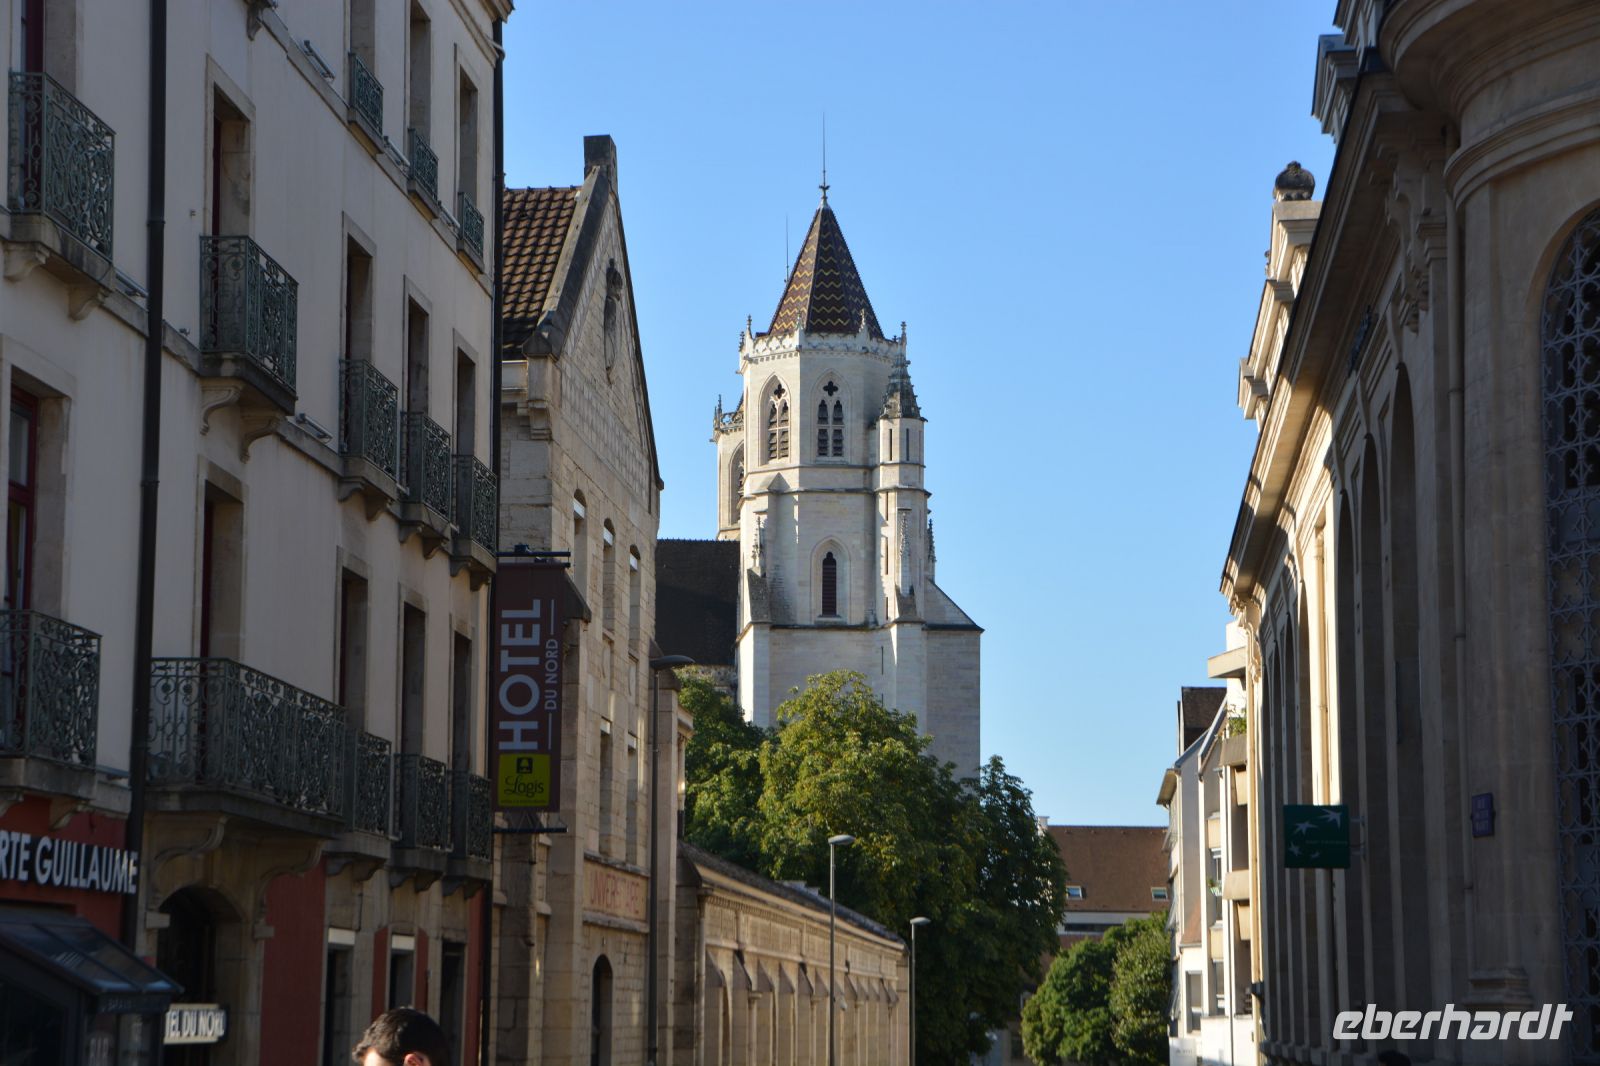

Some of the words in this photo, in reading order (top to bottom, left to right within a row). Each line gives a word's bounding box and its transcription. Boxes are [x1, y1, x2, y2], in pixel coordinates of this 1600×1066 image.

[498, 599, 541, 750] HOTEL
[545, 638, 559, 684] NORD
[544, 689, 557, 711] DU
[503, 775, 545, 797] Logis
[35, 835, 139, 894] GUILLAUME
[182, 1009, 197, 1037] DU
